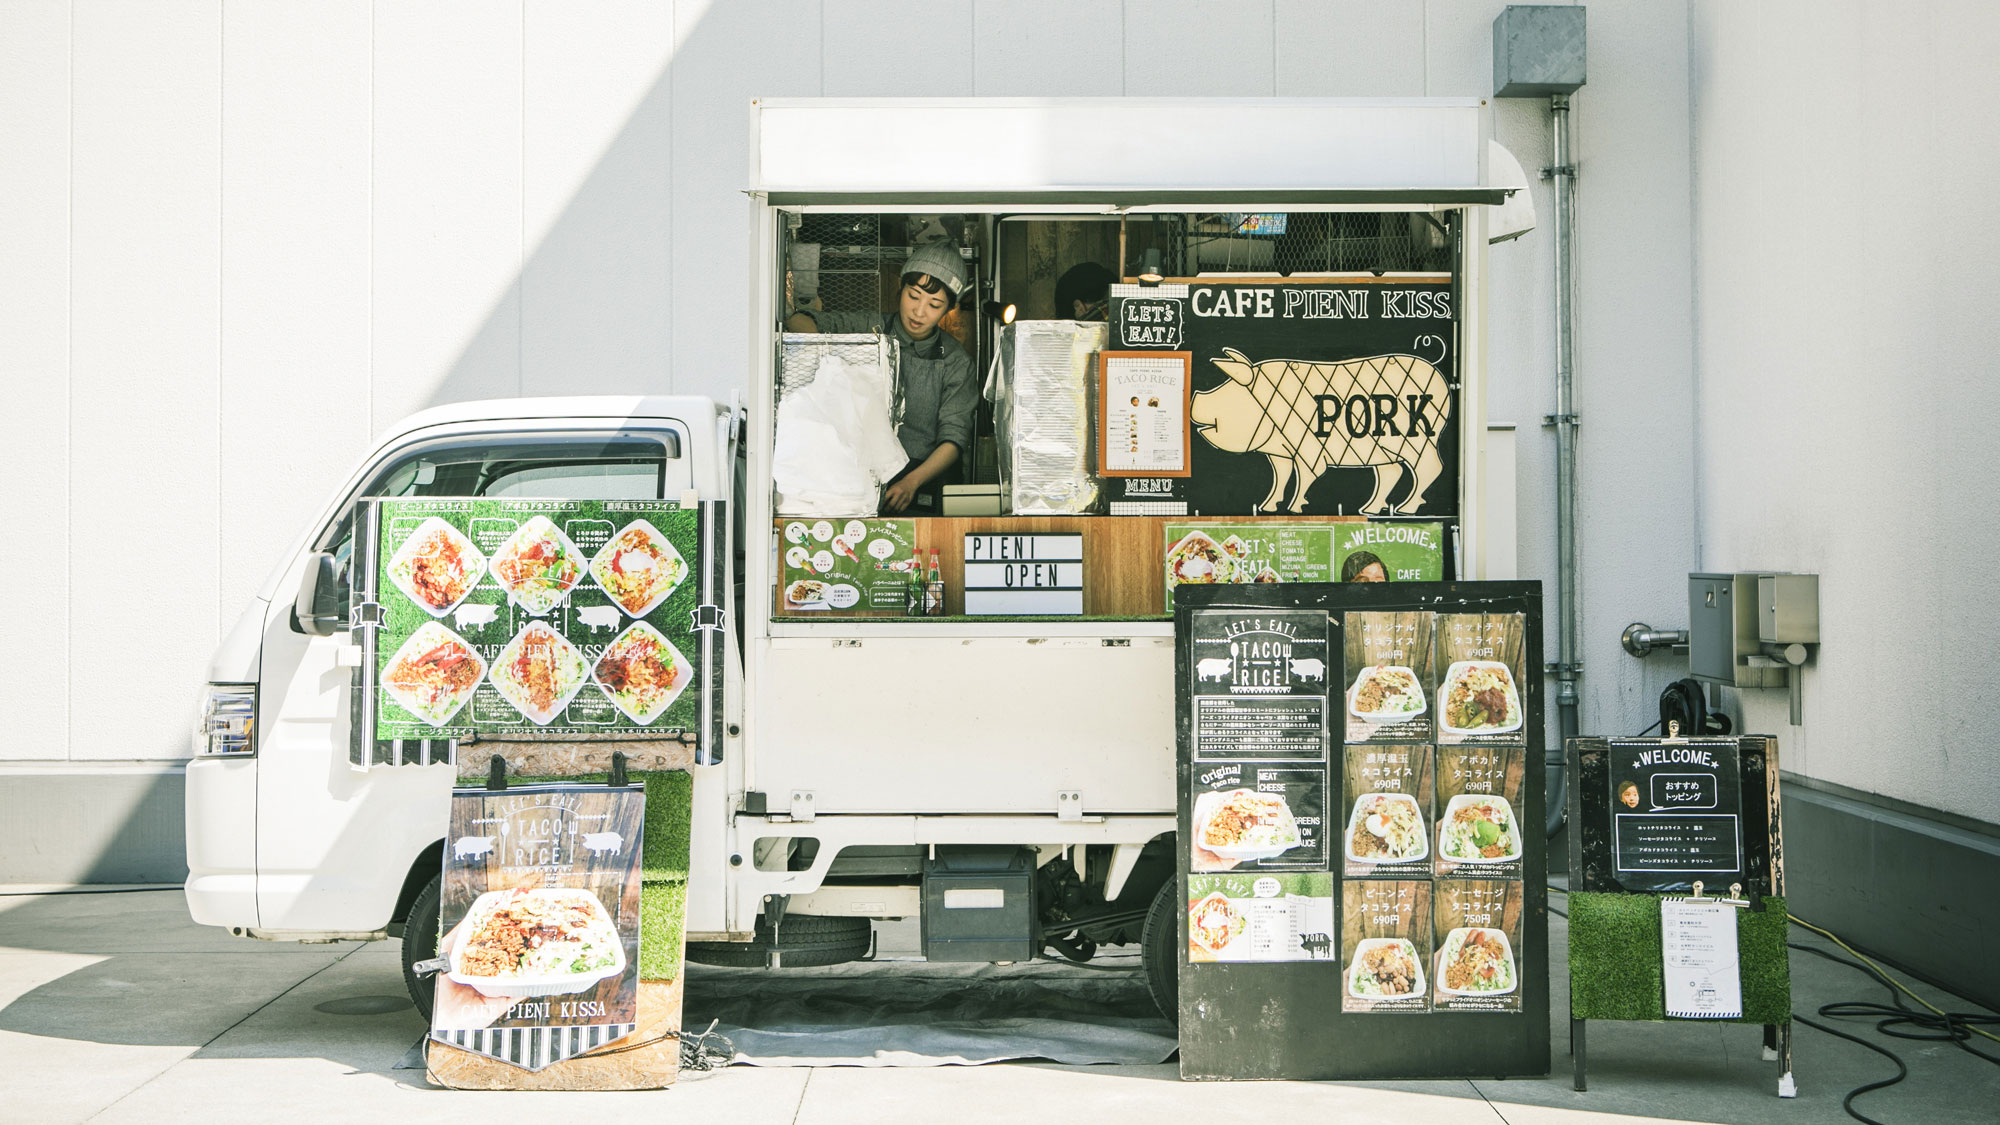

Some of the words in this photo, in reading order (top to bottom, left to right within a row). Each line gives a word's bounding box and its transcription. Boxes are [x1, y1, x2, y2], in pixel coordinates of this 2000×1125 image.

[1191, 288, 1275, 318] CAFE
[1283, 289, 1369, 319] PIENI
[1381, 291, 1451, 319] KISS
[1128, 326, 1176, 343] EAT!
[1115, 374, 1147, 385] TACO
[1151, 374, 1177, 386] RICE
[1314, 394, 1435, 438] PORK
[1125, 478, 1173, 492] MENU
[1351, 528, 1431, 547] WELCOME
[973, 537, 1034, 559] PIENI
[1005, 564, 1058, 587] OPEN
[1397, 569, 1421, 580] CAFE
[1225, 619, 1261, 638] LET'S
[1270, 619, 1297, 637] EAT!
[1363, 623, 1415, 632] オリジナル
[1454, 622, 1504, 631] ホットチリ
[1364, 637, 1415, 646] タコライス
[1455, 636, 1504, 645] タコライス
[1241, 642, 1282, 658] TACO
[1466, 647, 1494, 657] 690円
[1241, 669, 1282, 686] RICE
[1366, 754, 1408, 764] 濃厚温玉
[1459, 756, 1499, 764] アボカド
[1639, 749, 1712, 766] WELCOME
[1200, 764, 1242, 784] Original
[1362, 767, 1412, 776] タコライス
[1454, 769, 1503, 778] タコライス
[1211, 780, 1228, 790] Taco
[1227, 777, 1241, 785] rice
[1373, 779, 1401, 789] 690円
[1465, 781, 1492, 791] 690円
[1665, 782, 1699, 790] おすすめ
[1665, 792, 1701, 801] トッピング
[501, 794, 541, 812] LET'S
[551, 795, 582, 812] EAT!
[518, 818, 562, 836] TACO
[515, 847, 560, 866] RICE
[1190, 877, 1221, 895] LET'S
[1226, 879, 1250, 897] EAT!
[1452, 888, 1504, 897] ソーセージ
[1366, 888, 1407, 898] ビーンズ
[1361, 903, 1412, 912] タコライス
[1452, 902, 1503, 911] タコライス
[1373, 914, 1400, 925] 690円
[1464, 914, 1491, 924] 750円
[1305, 933, 1325, 942] PORK
[506, 1003, 550, 1019] PIENI
[561, 1001, 606, 1017] KISSA
